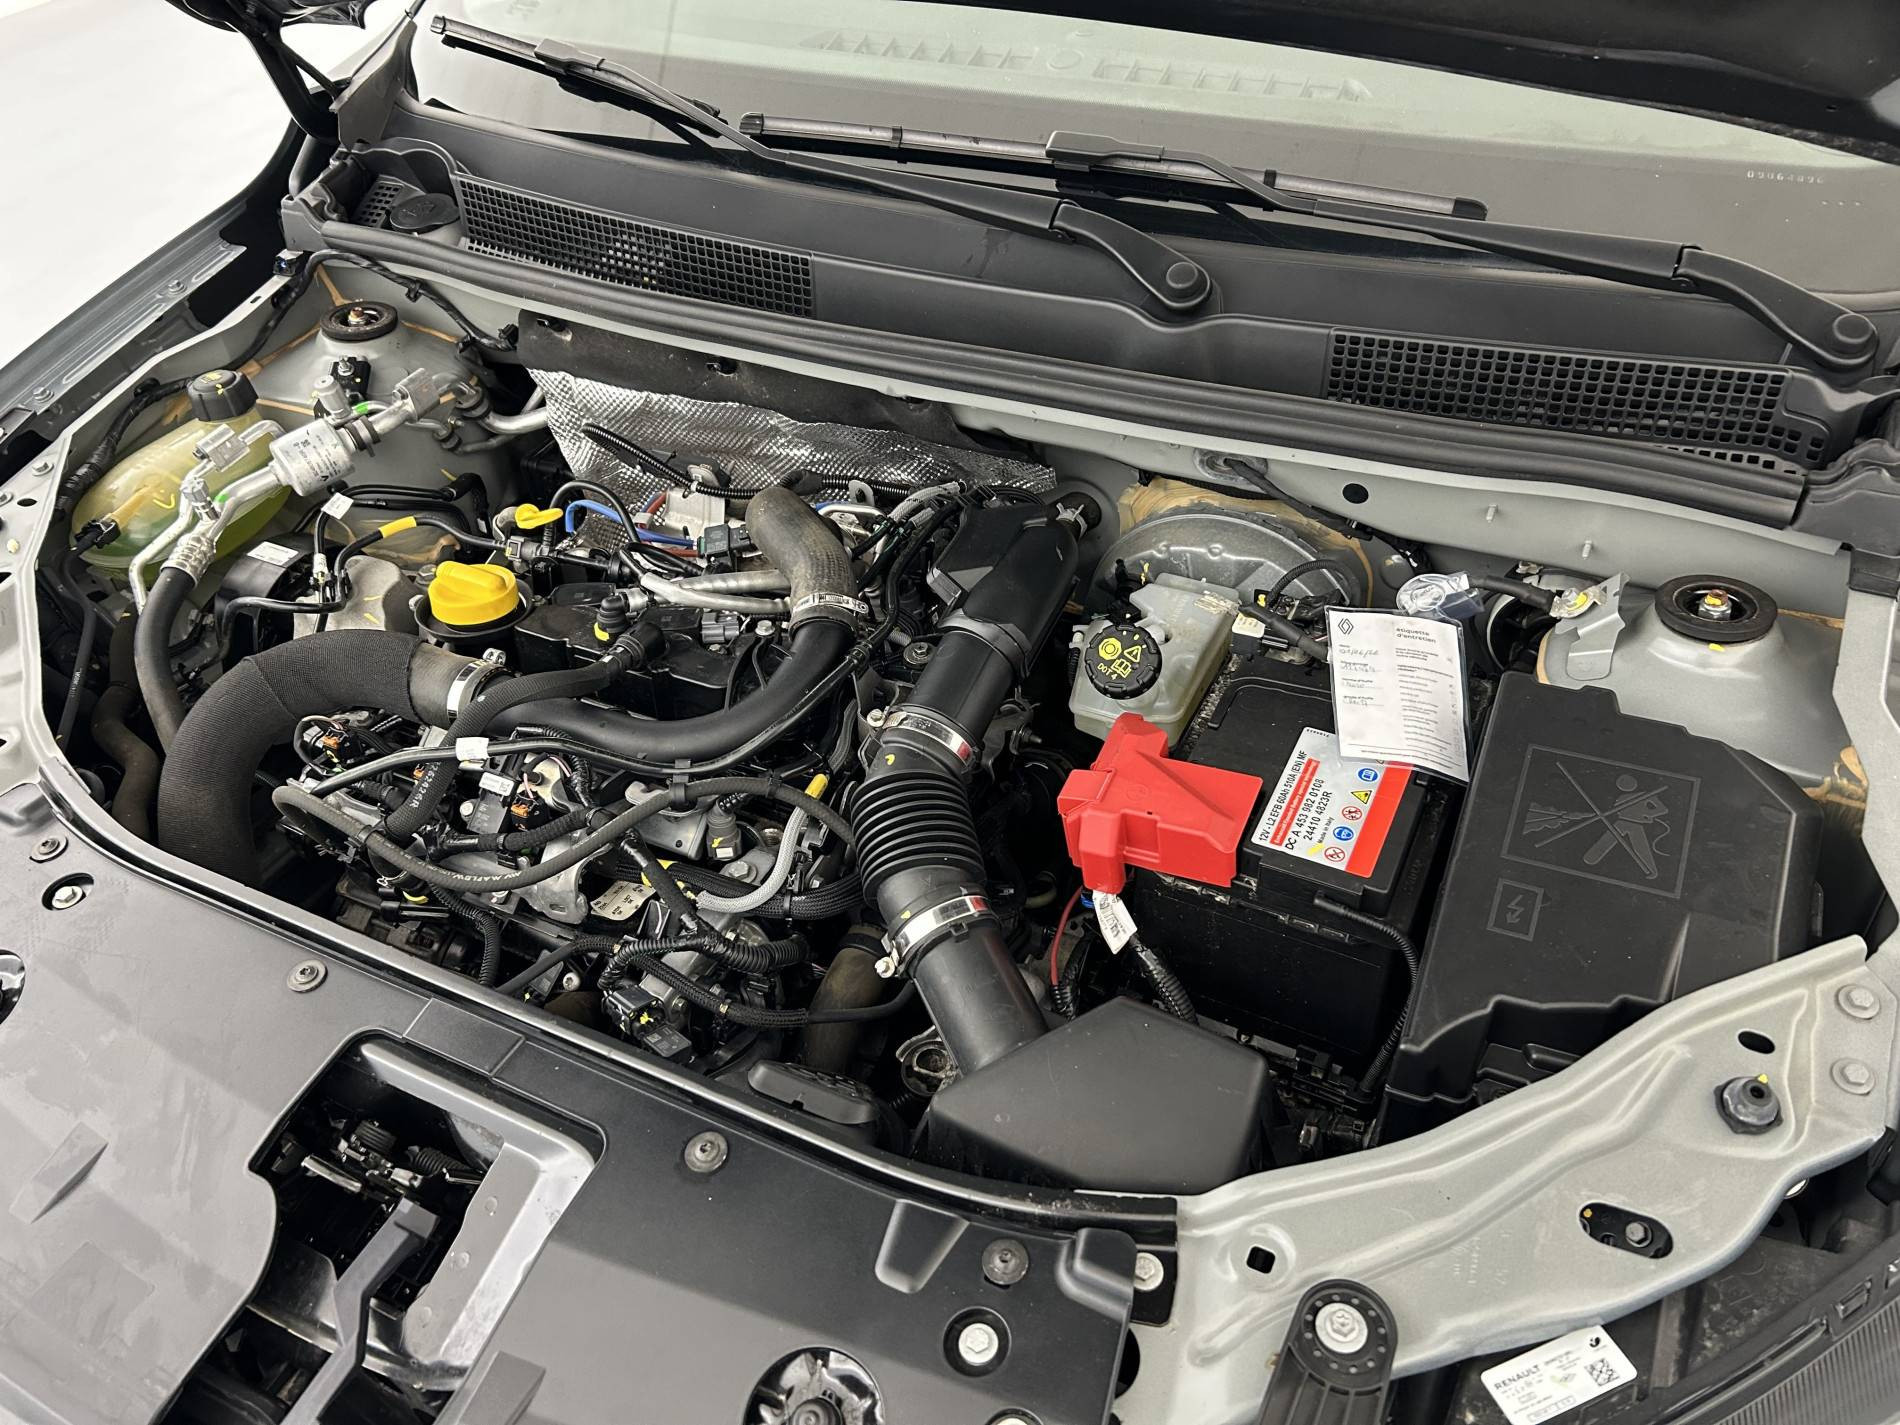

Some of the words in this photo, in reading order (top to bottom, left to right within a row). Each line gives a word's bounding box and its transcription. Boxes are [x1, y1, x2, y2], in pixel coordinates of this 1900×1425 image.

[1097, 663, 1113, 676] DOT
[1297, 750, 1307, 761] MF
[1291, 759, 1304, 774] (EN)
[1284, 773, 1296, 788] 510A
[1278, 788, 1289, 804] 60Ah
[1270, 804, 1282, 819] EFB
[1285, 838, 1297, 850] DC
[1296, 814, 1309, 828] 453
[1303, 798, 1315, 813] 982
[1309, 778, 1324, 798] 0108
[1303, 816, 1321, 841] 24410
[1316, 791, 1332, 815] 4823R
[1266, 817, 1275, 826] L2
[1259, 828, 1270, 841] 12V
[1493, 1364, 1541, 1390] RENAULT
